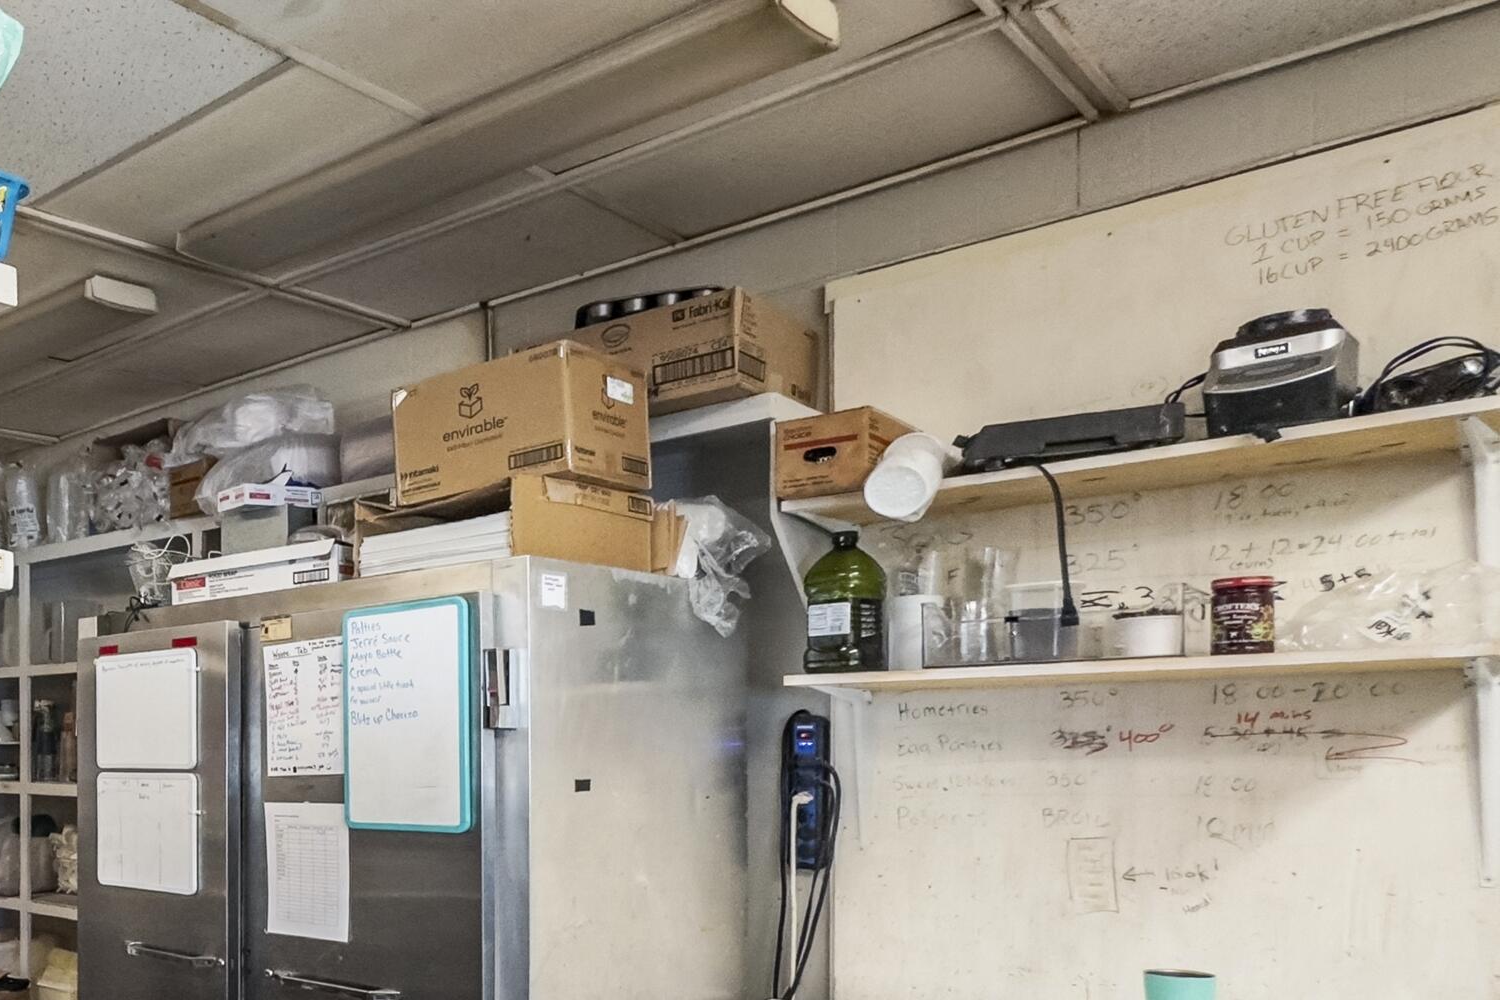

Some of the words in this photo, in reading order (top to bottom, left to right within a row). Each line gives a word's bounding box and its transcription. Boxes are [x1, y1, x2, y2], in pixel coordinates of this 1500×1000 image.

[1225, 206, 1329, 246] GLUTEN
[1336, 183, 1406, 218] FREE
[1251, 242, 1274, 264] 1
[1280, 230, 1325, 253] CUP
[1367, 208, 1411, 230] 150
[1416, 186, 1487, 216] GRAMS
[442, 417, 505, 443] envirable
[1236, 710, 1260, 726] 14
